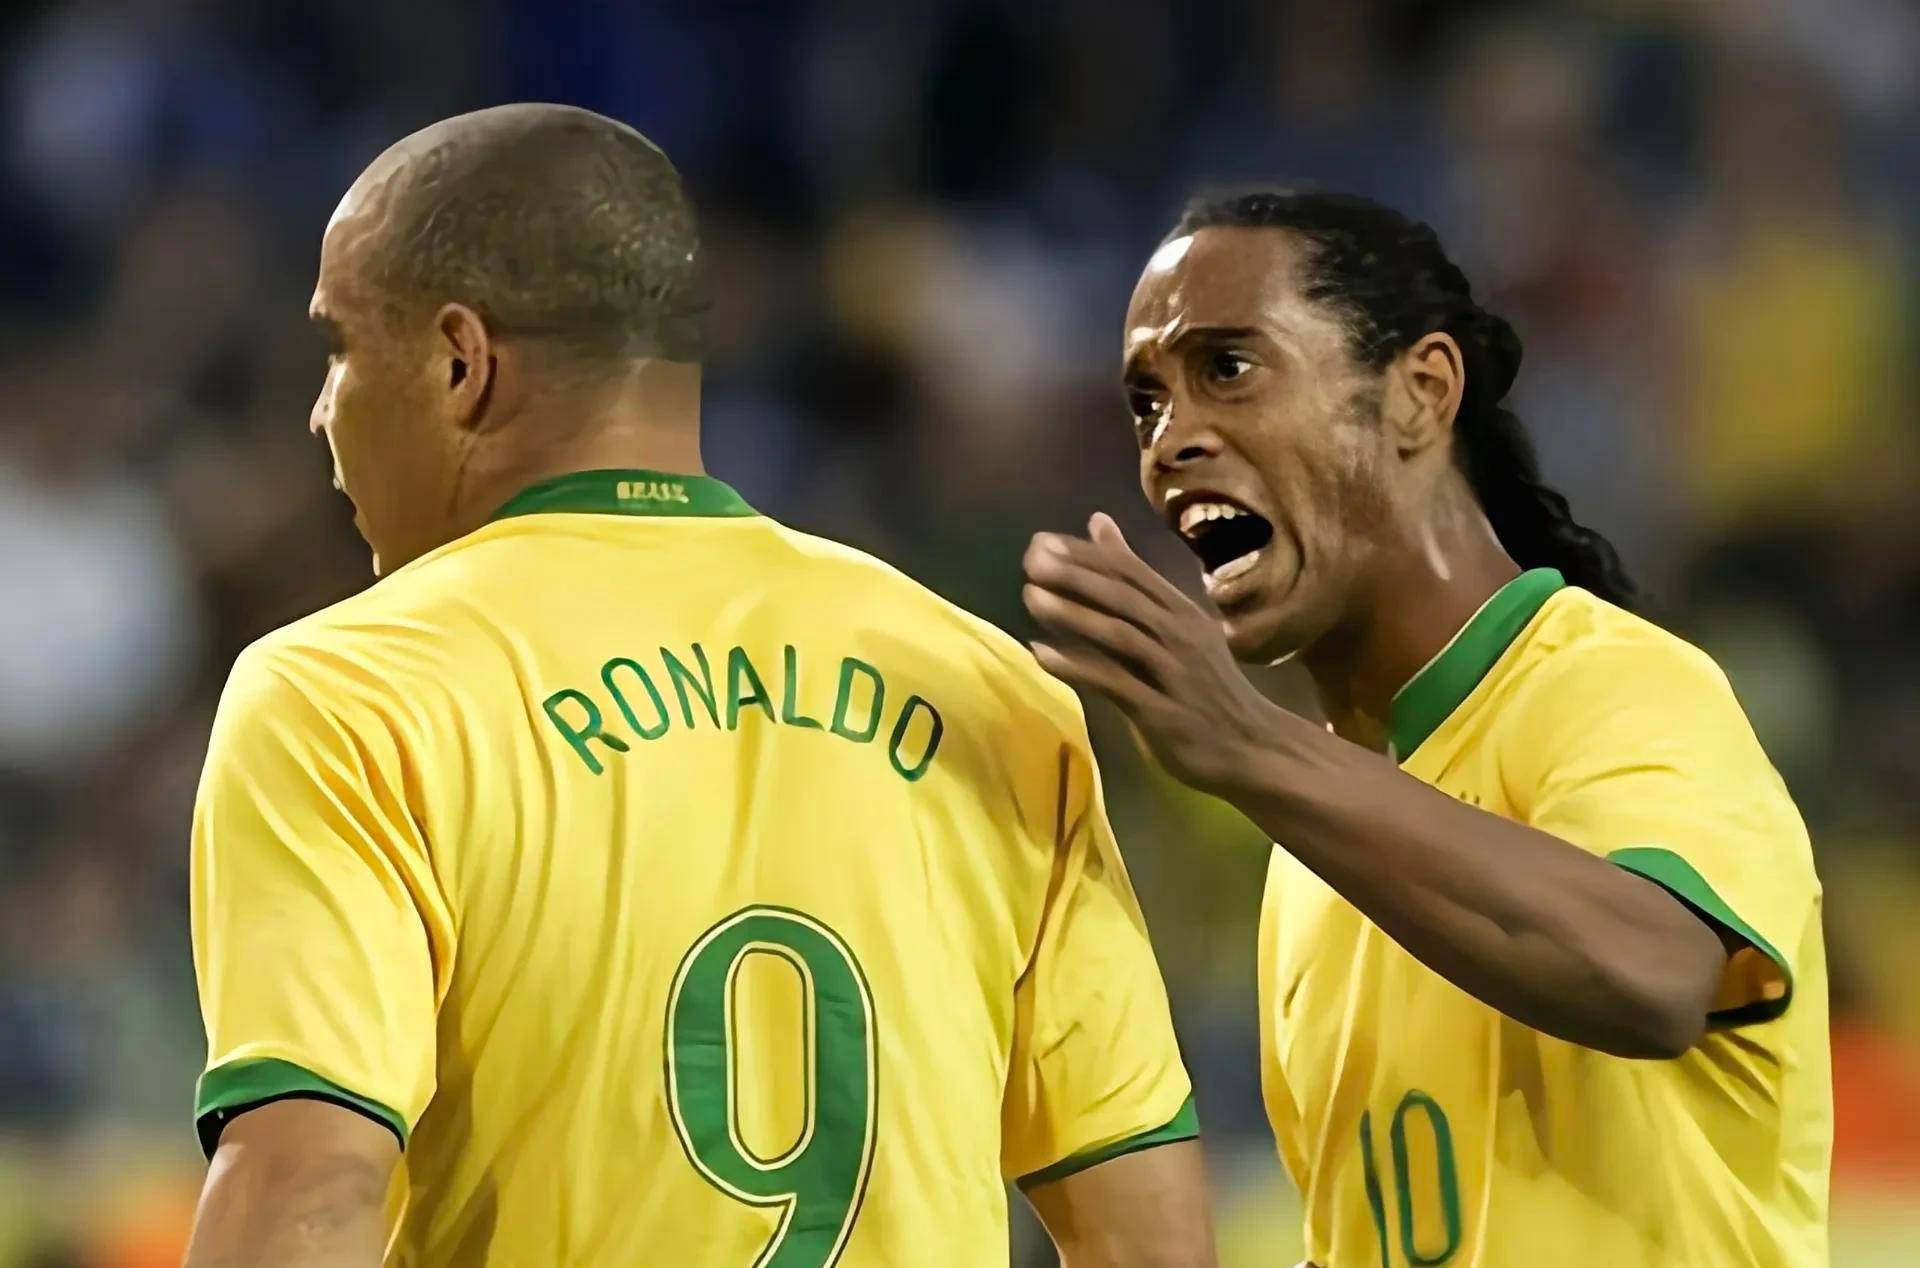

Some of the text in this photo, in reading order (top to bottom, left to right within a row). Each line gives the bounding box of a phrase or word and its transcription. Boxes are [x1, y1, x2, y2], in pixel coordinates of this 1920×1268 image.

[542, 642, 943, 782] RONALDO
[662, 903, 879, 1268] 9
[1359, 1088, 1462, 1268] 10
